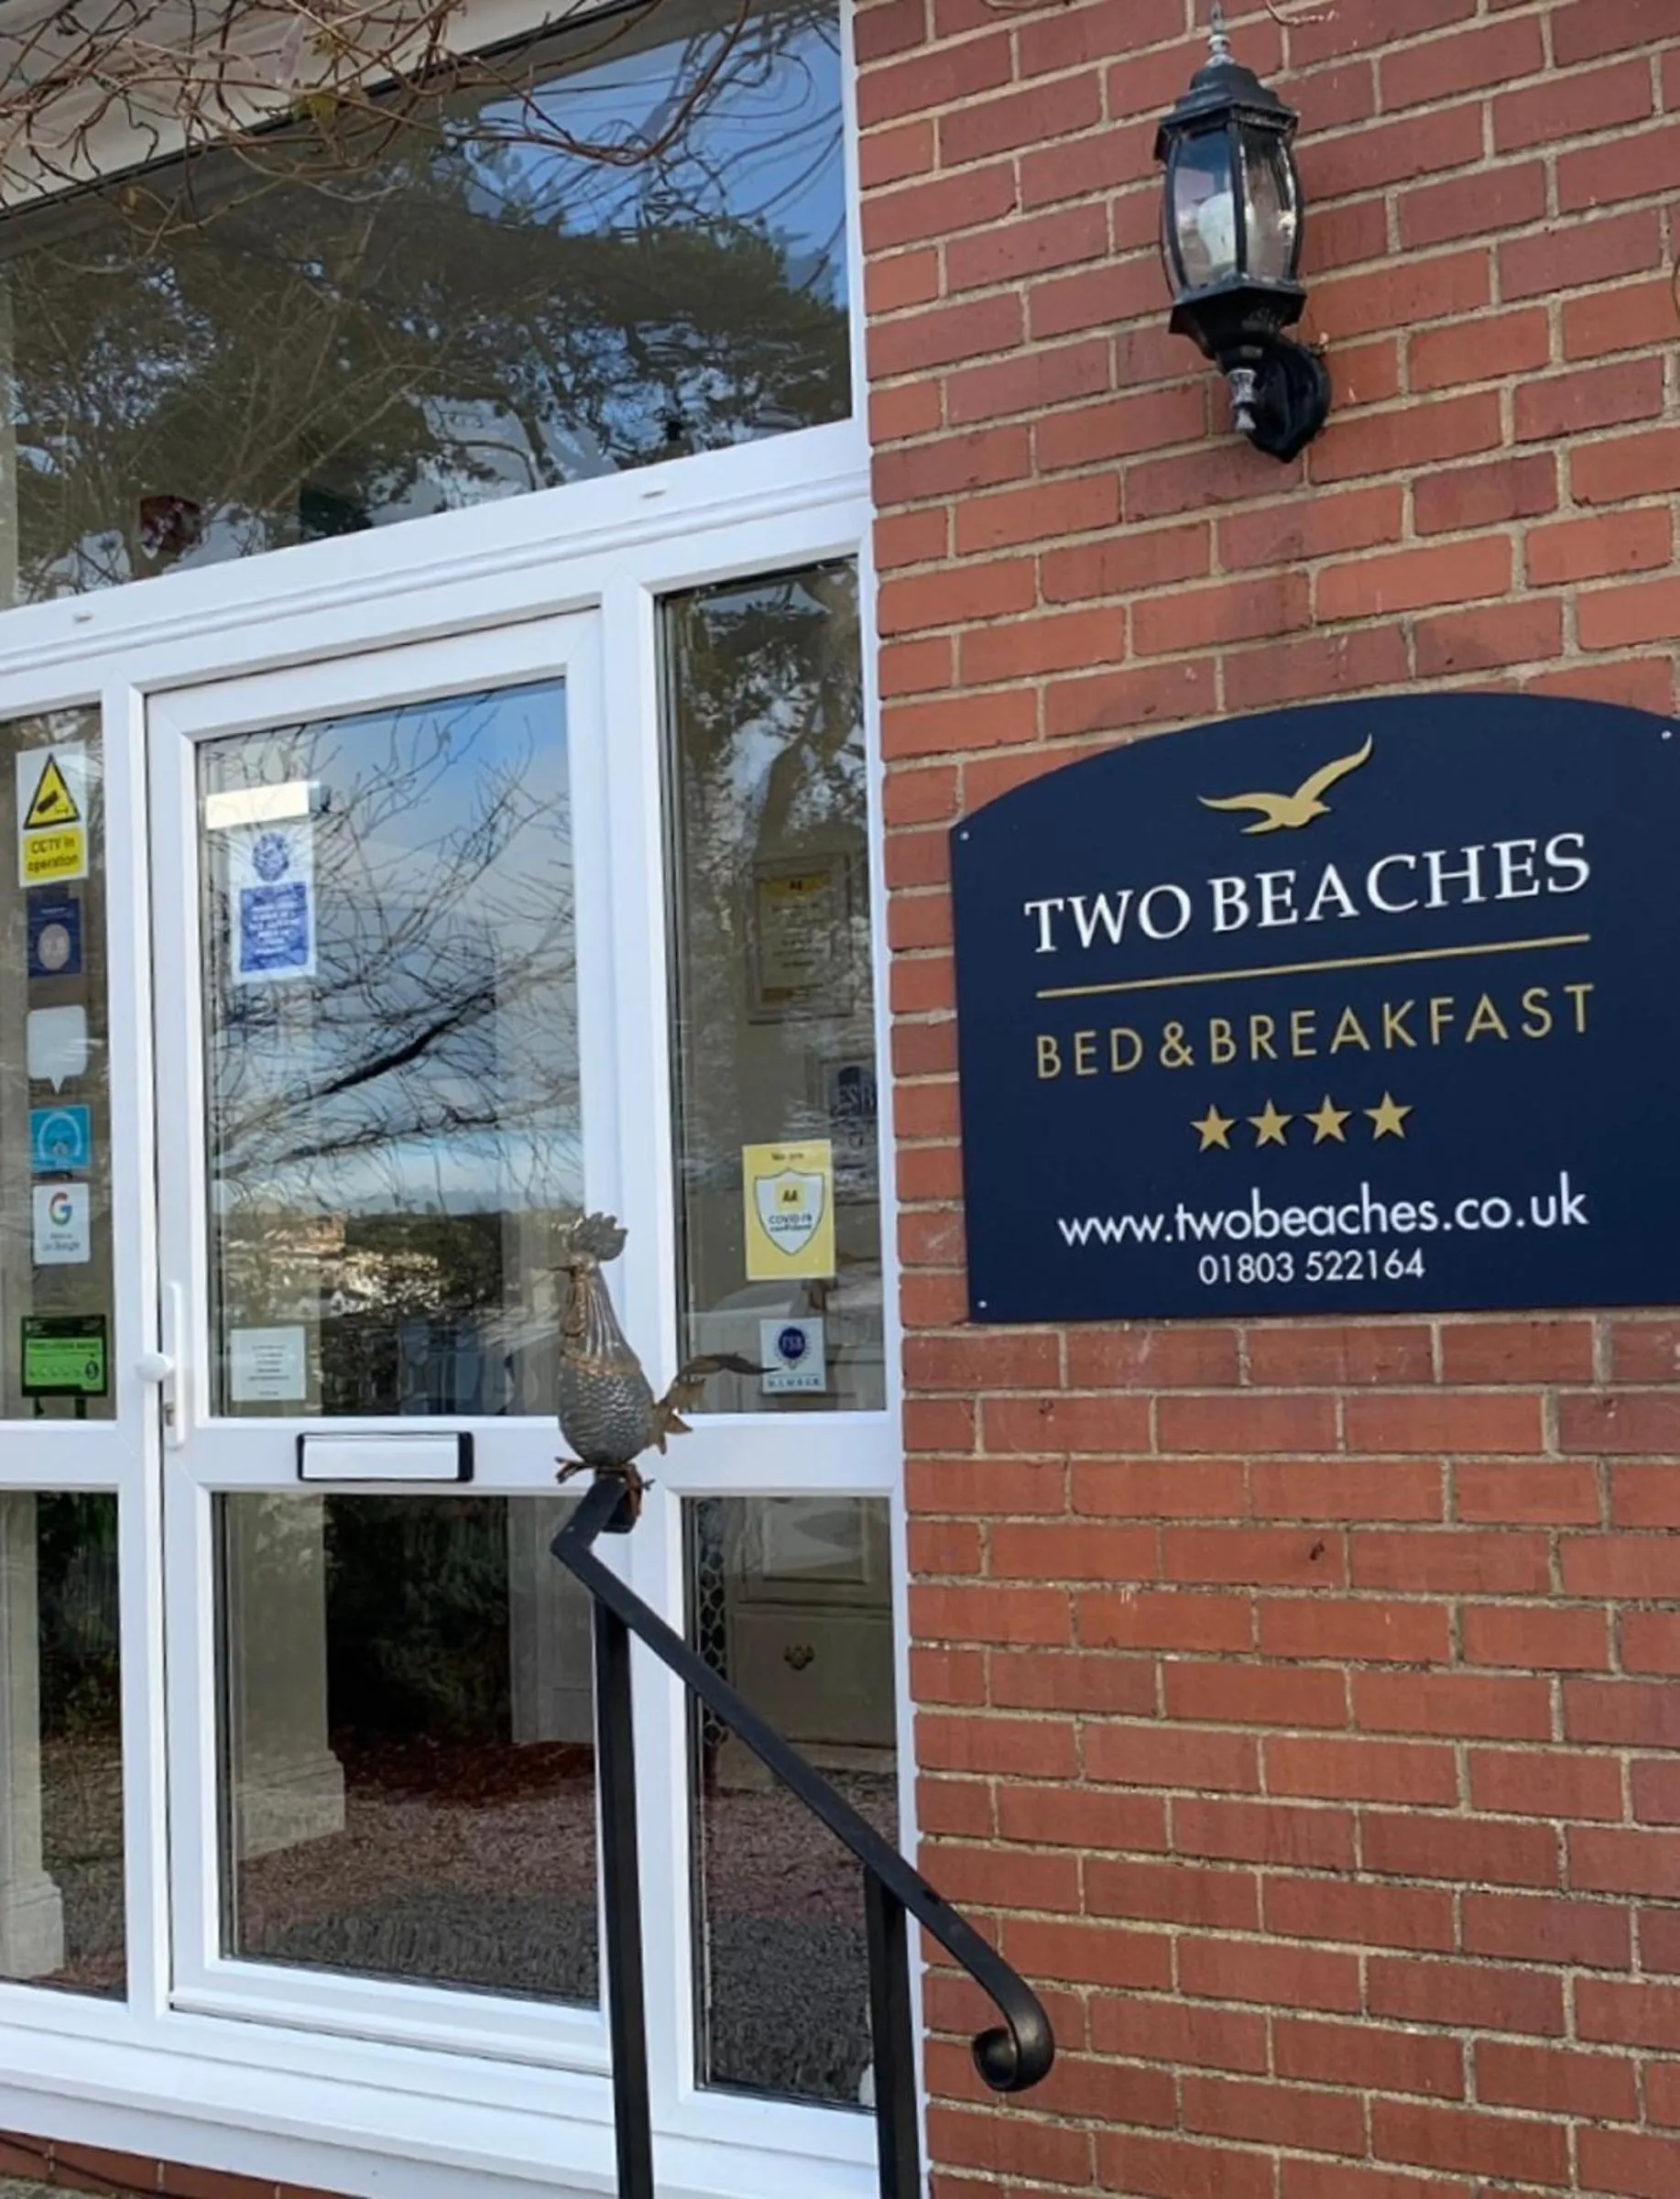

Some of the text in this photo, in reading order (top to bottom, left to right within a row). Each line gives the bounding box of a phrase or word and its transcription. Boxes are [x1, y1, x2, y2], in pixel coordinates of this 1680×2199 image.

[27, 853, 79, 872] operation
[30, 836, 75, 855] CCTV in
[1024, 832, 1591, 953] TWO BEACHES
[1057, 1170, 1589, 1246] www.twobeaches.co.uk
[1197, 1247, 1425, 1285] 01803 522164
